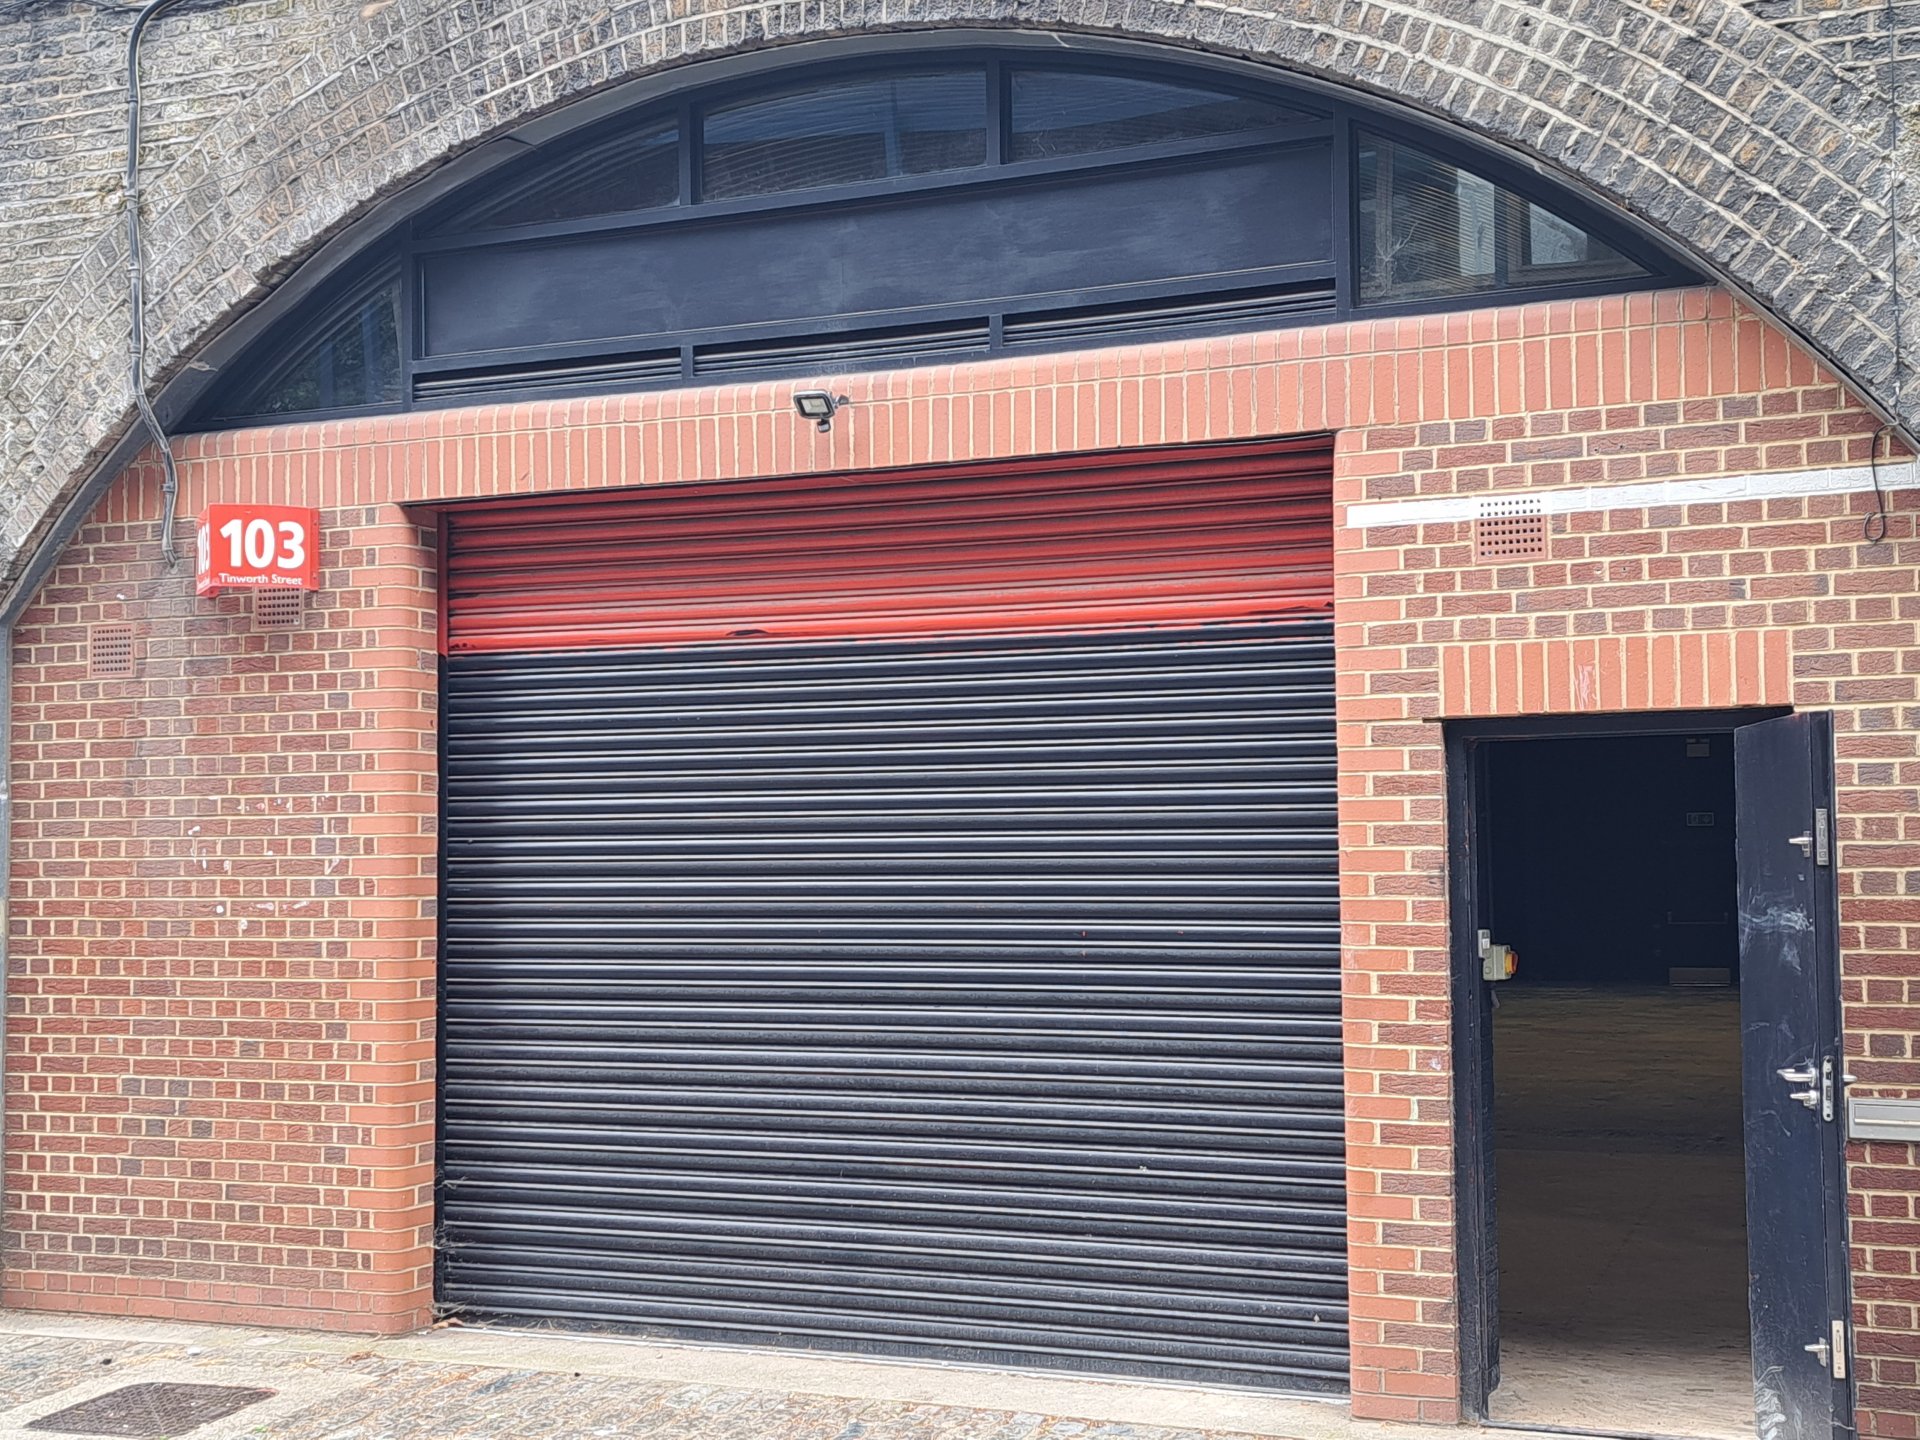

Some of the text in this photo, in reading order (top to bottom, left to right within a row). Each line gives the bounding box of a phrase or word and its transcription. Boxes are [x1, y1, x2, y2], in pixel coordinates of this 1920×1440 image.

[219, 518, 305, 569] 103
[218, 573, 268, 584] Tinworth
[271, 574, 303, 586] Street
